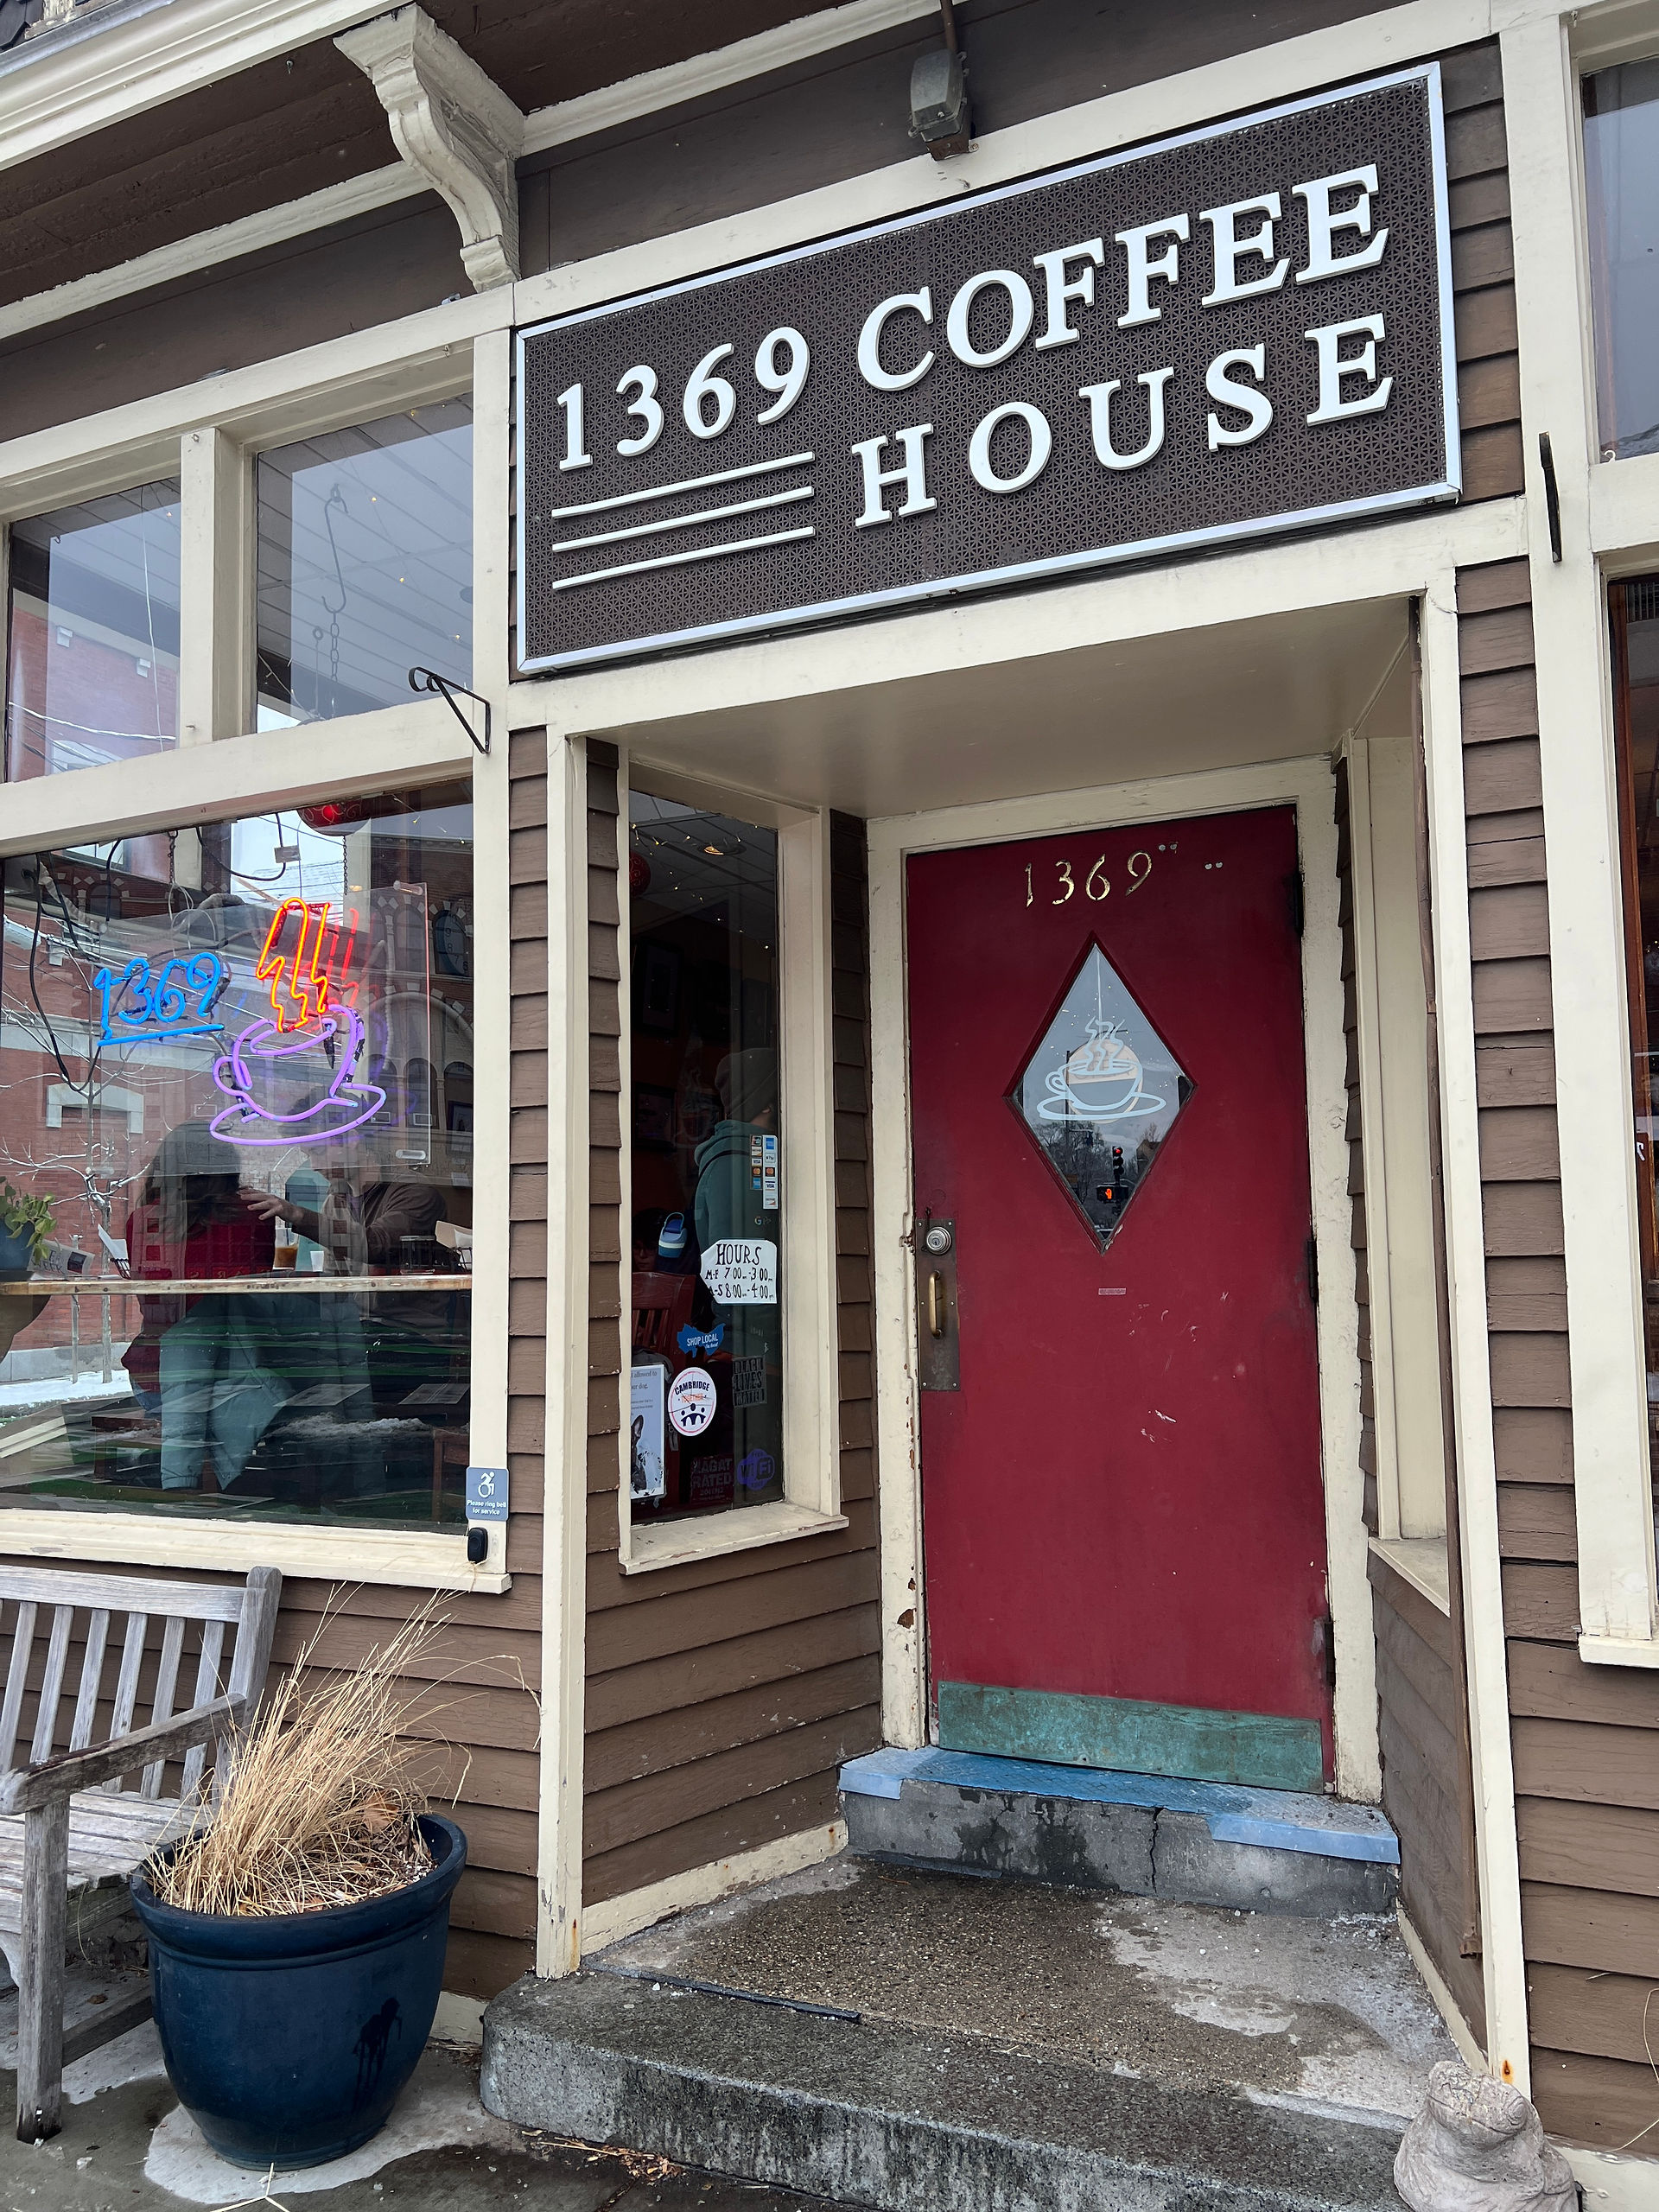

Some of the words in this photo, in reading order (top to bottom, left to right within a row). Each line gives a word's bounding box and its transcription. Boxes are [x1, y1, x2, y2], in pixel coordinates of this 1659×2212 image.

[556, 325, 811, 473] 1369
[856, 162, 1390, 394] COFFEE
[851, 312, 1395, 528] HOUSE
[1024, 850, 1153, 907] 1369
[92, 951, 223, 1039] 1369
[715, 1243, 762, 1266] HOURS
[705, 1268, 719, 1281] M-F
[686, 1336, 702, 1347] SHOP
[702, 1333, 719, 1344] LOCAL
[674, 1380, 710, 1395] CAMBRIDGE
[692, 1471, 733, 1488] RATED
